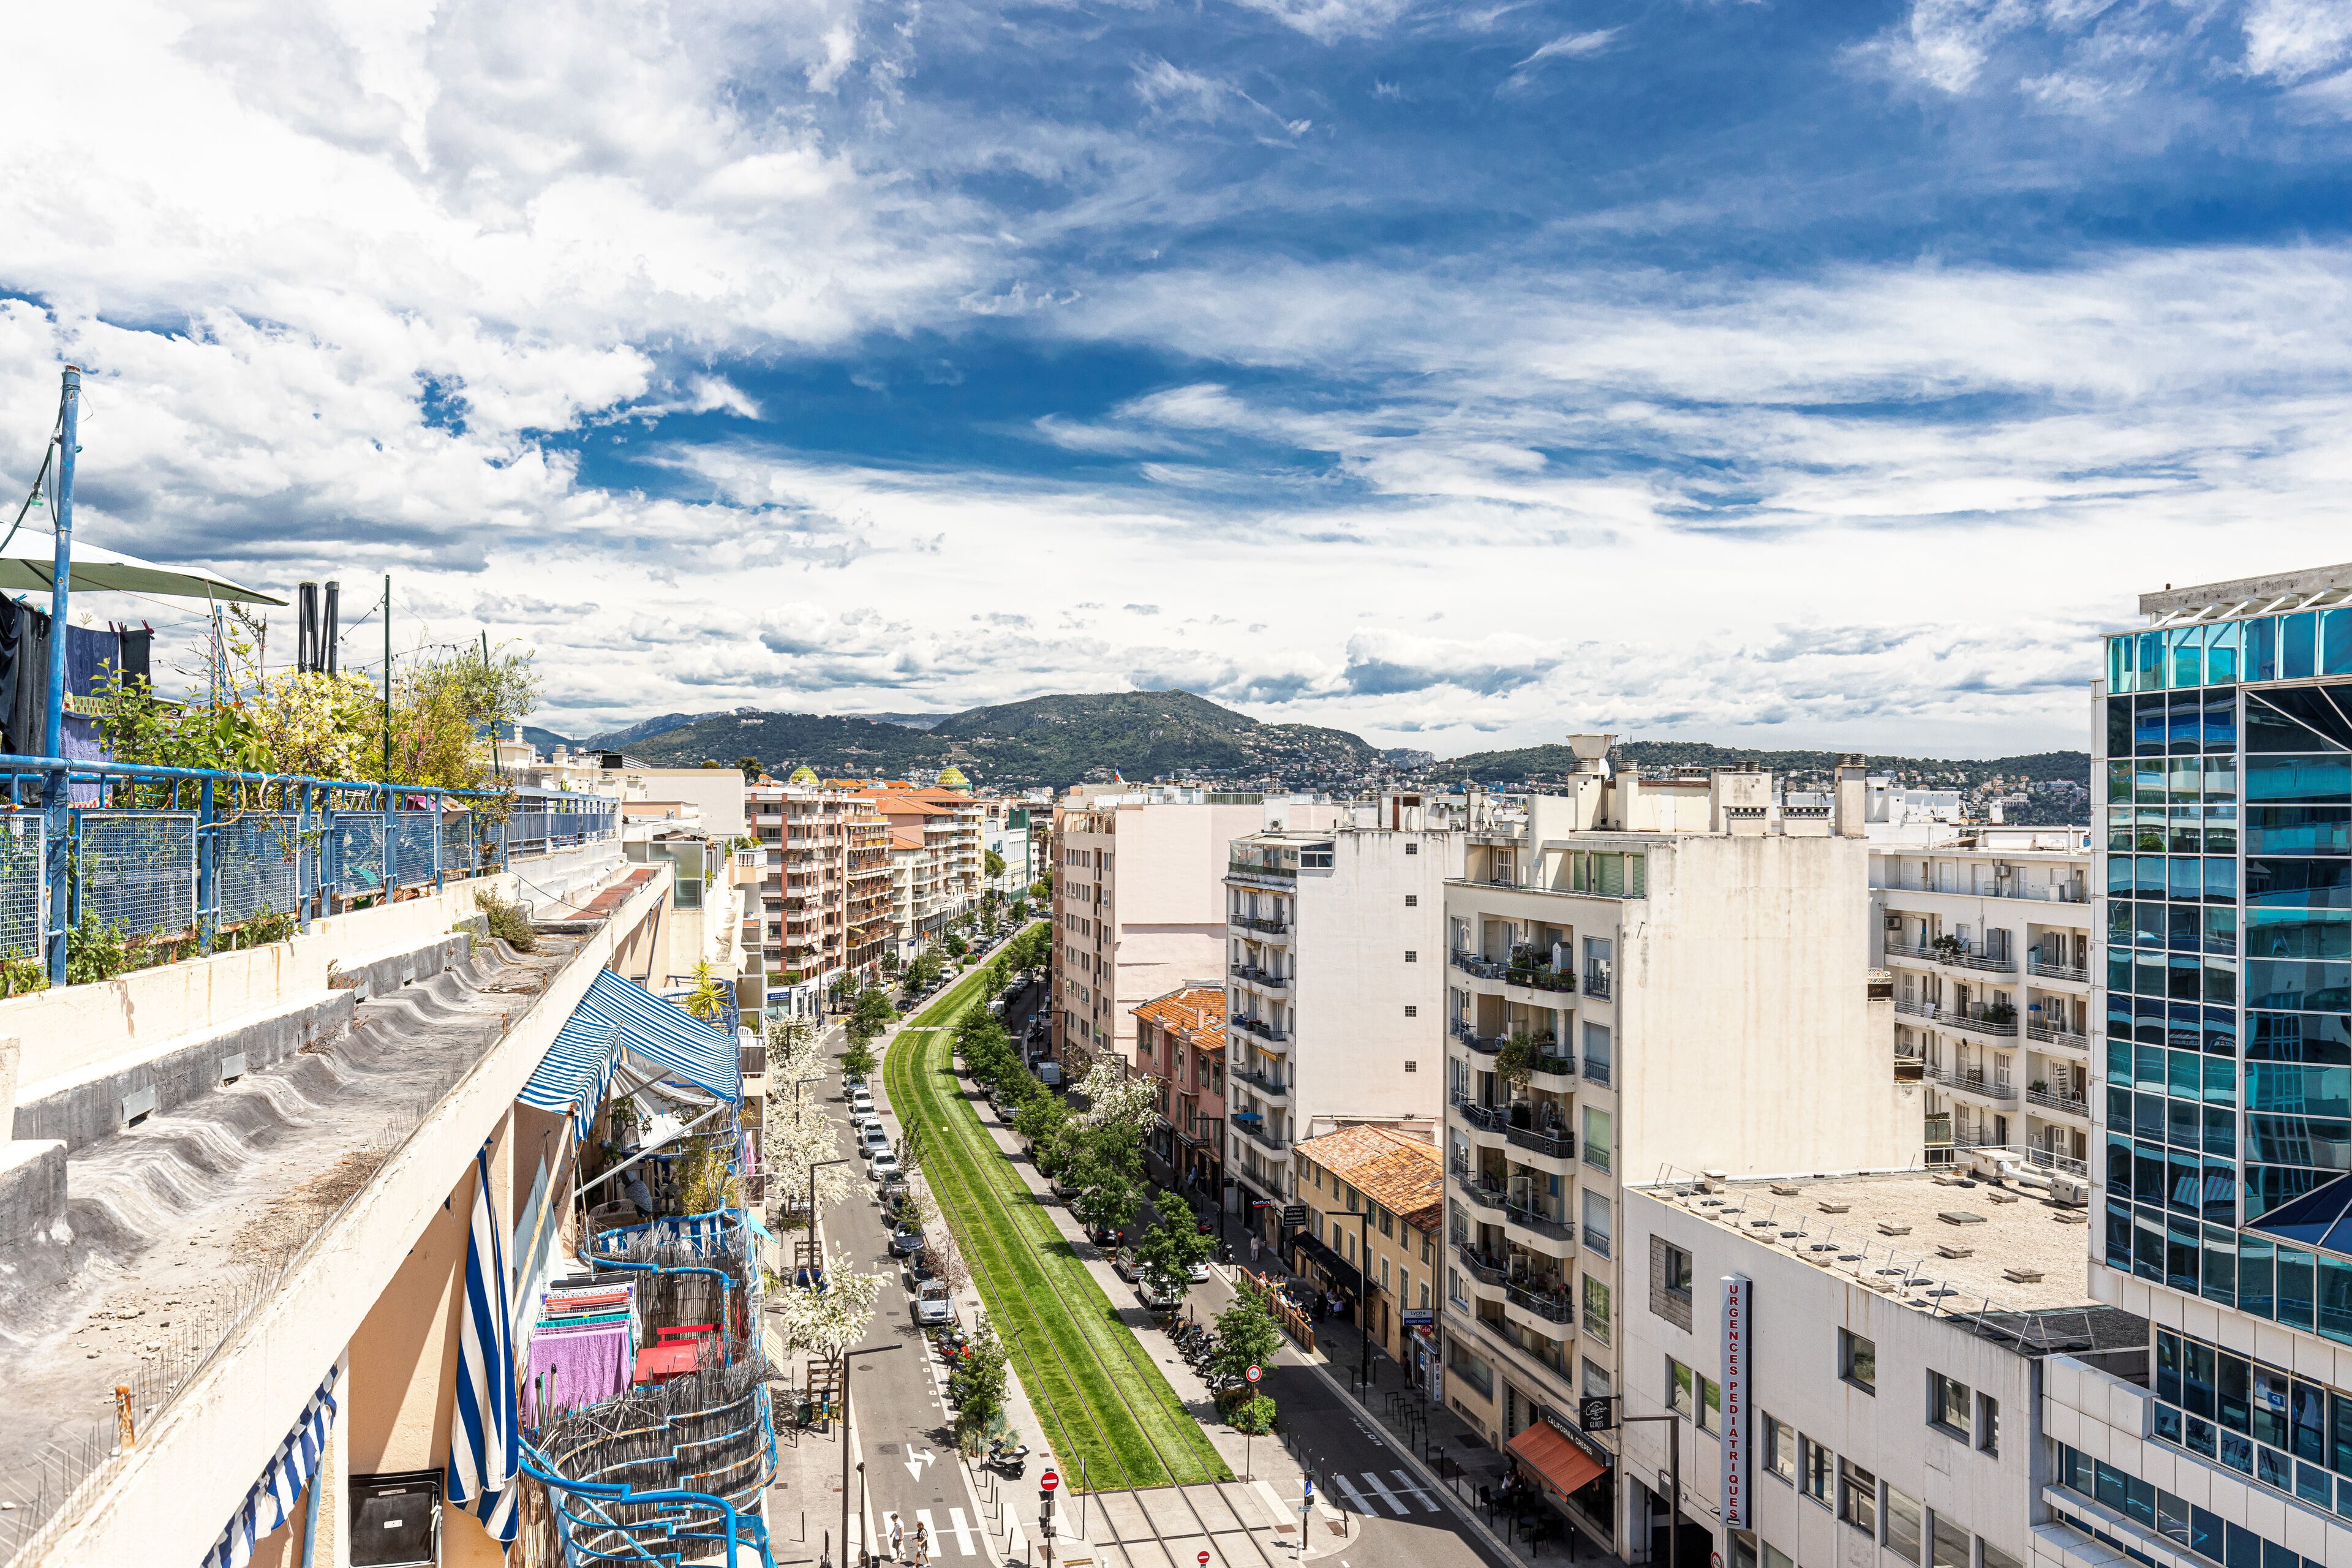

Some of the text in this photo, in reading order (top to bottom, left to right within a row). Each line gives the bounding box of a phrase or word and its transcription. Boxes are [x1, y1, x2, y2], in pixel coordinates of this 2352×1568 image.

[919, 1357, 940, 1408] MOTOS
[1728, 1284, 1739, 1519] URGENCES PEDIATRIQUES
[1547, 1415, 1574, 1441] CALIFORNIA
